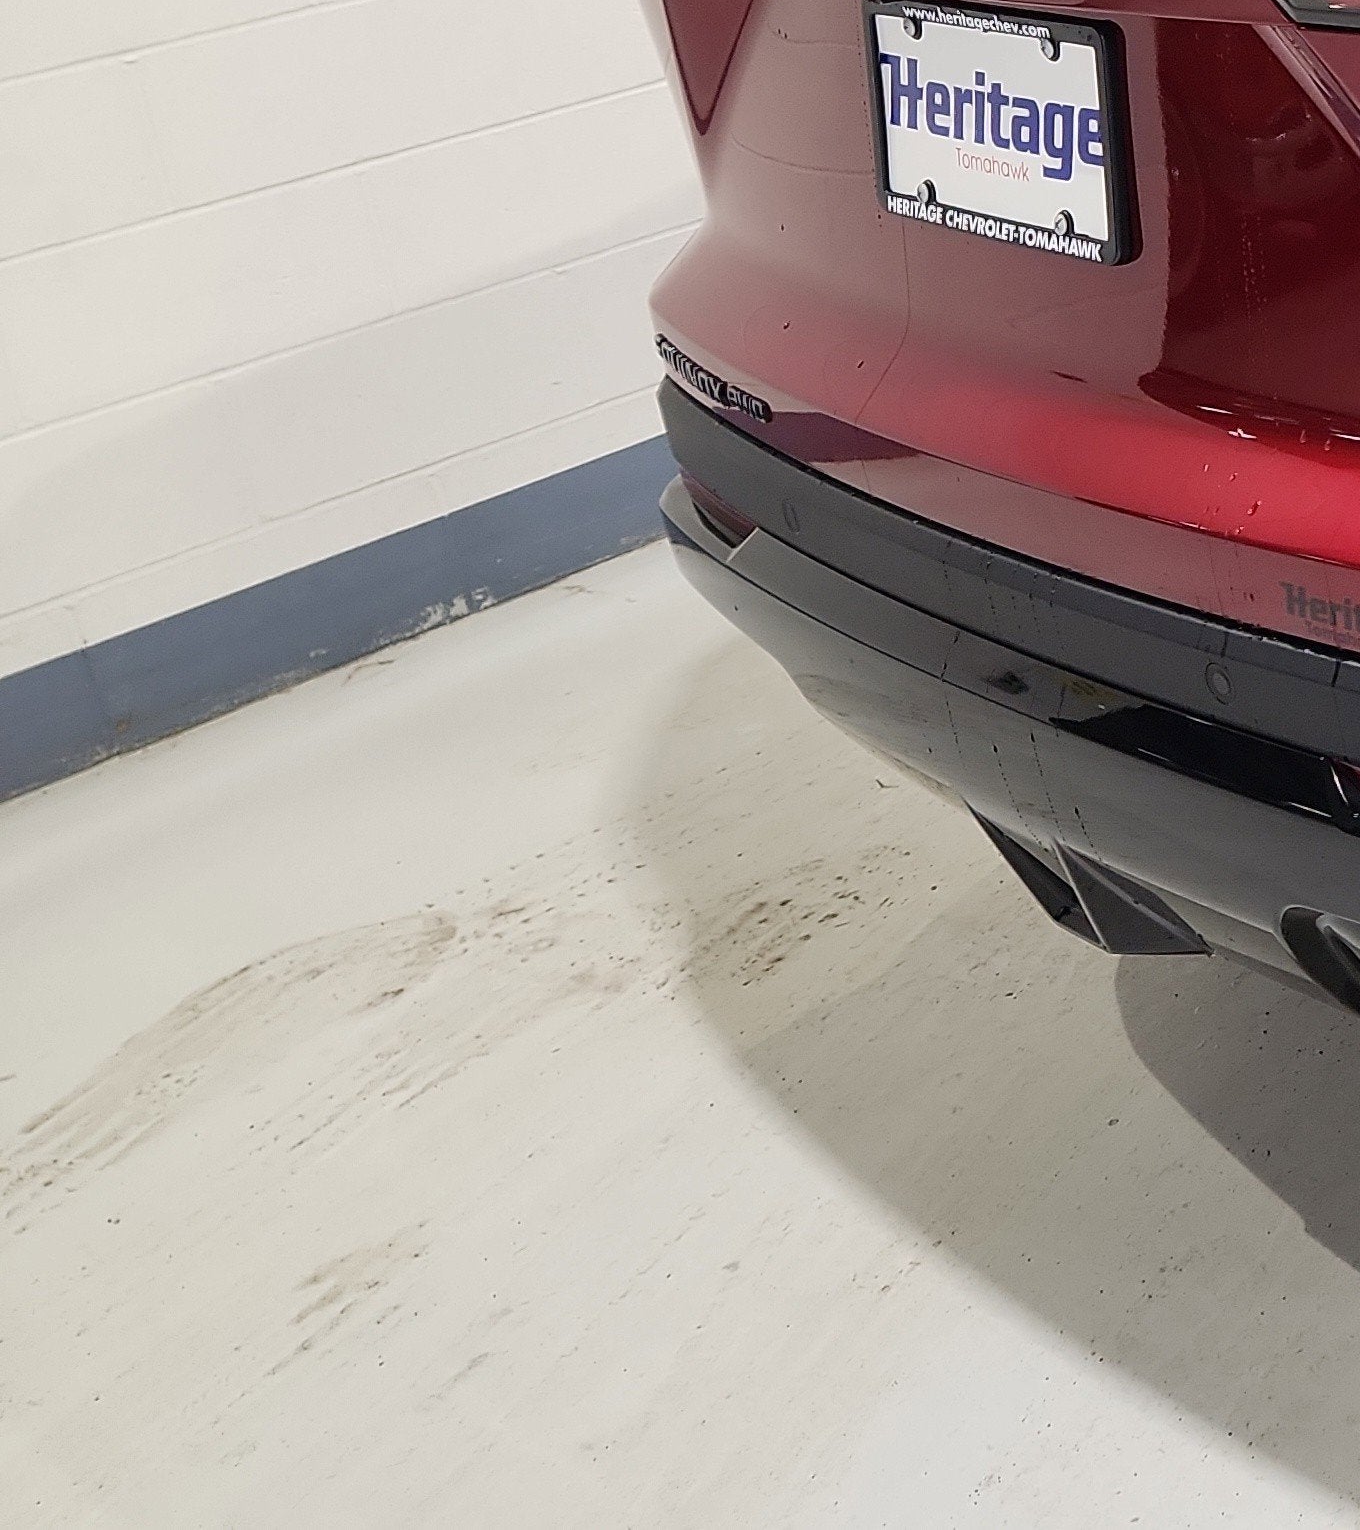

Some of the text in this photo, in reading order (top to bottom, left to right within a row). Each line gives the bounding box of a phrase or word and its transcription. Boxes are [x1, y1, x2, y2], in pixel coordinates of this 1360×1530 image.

[902, 6, 1050, 38] www.heritagechev.com
[880, 52, 1104, 182] Heritage
[955, 147, 1030, 183] Tomahawk
[887, 194, 1102, 262] HERITAGE CHEVROLET-TOMAHAWK
